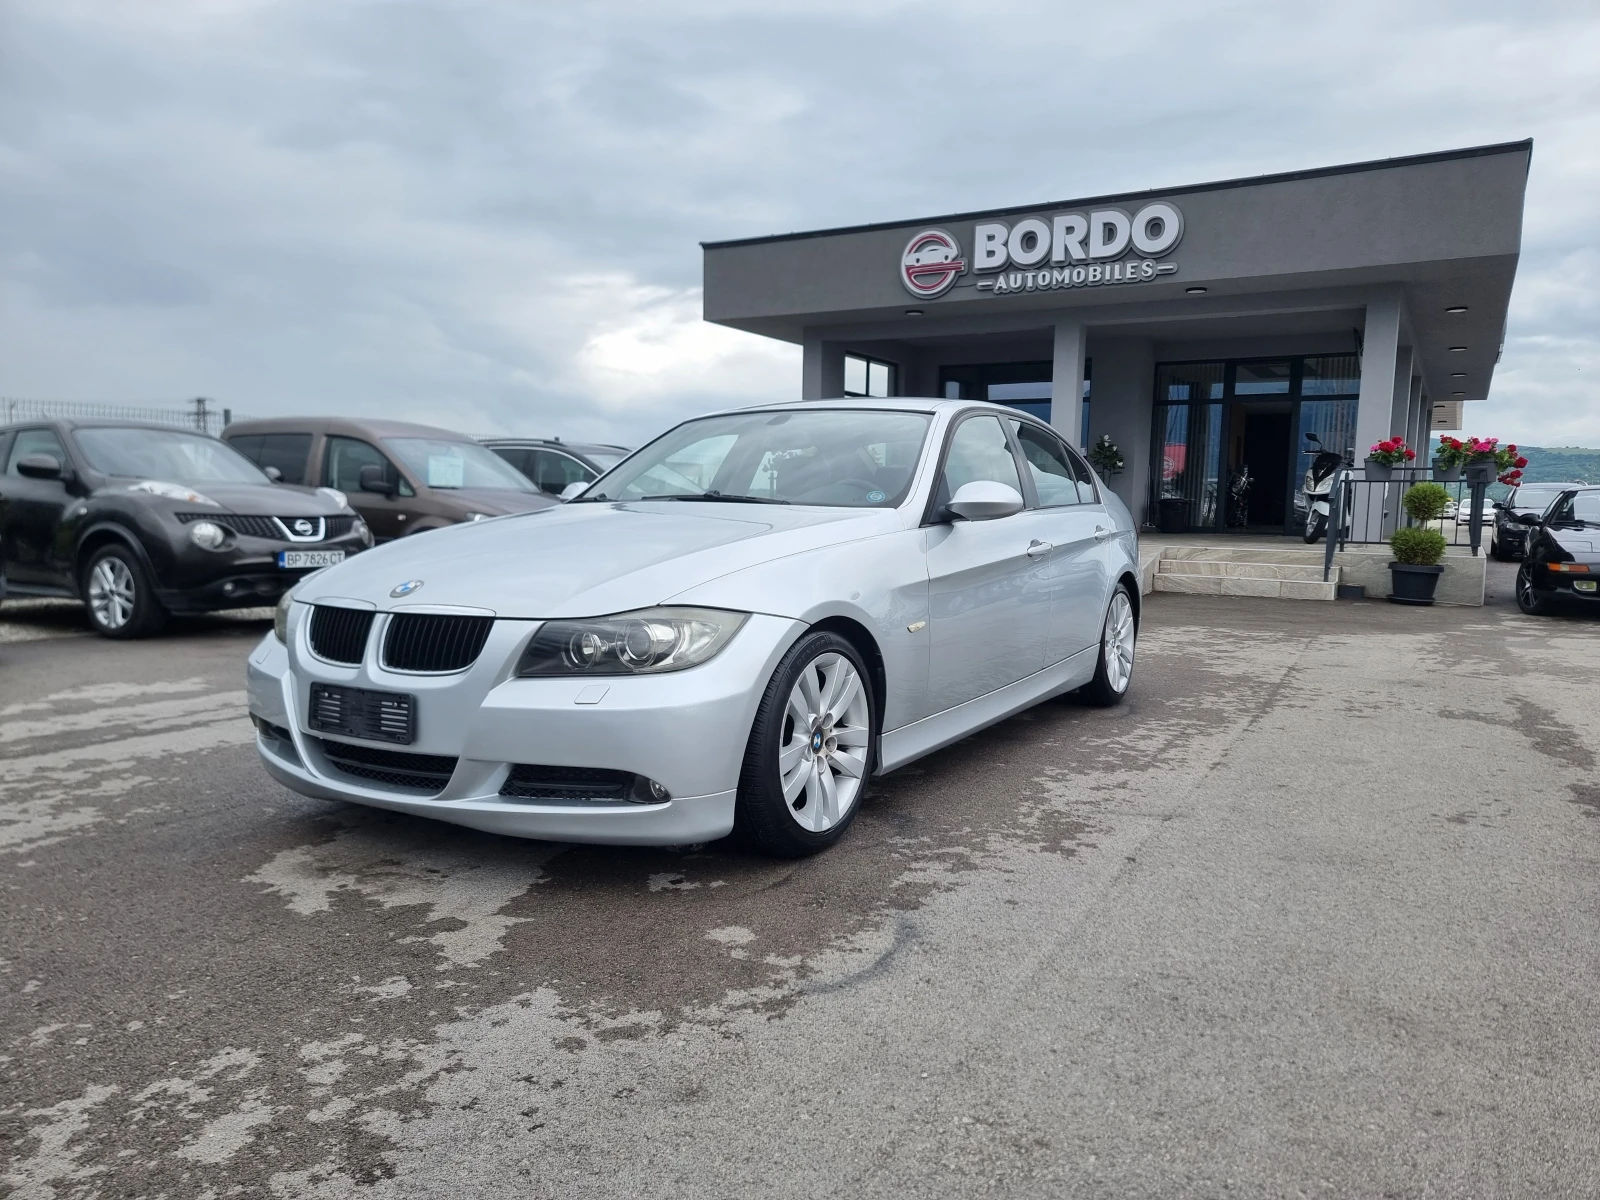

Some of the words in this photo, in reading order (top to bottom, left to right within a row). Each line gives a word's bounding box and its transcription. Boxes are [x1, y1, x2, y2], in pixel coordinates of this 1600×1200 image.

[974, 204, 1180, 269] BORDO
[995, 261, 1154, 290] AUTOMOBILES
[287, 554, 301, 566] BP
[303, 553, 329, 566] 7826
[330, 553, 343, 565] CT
